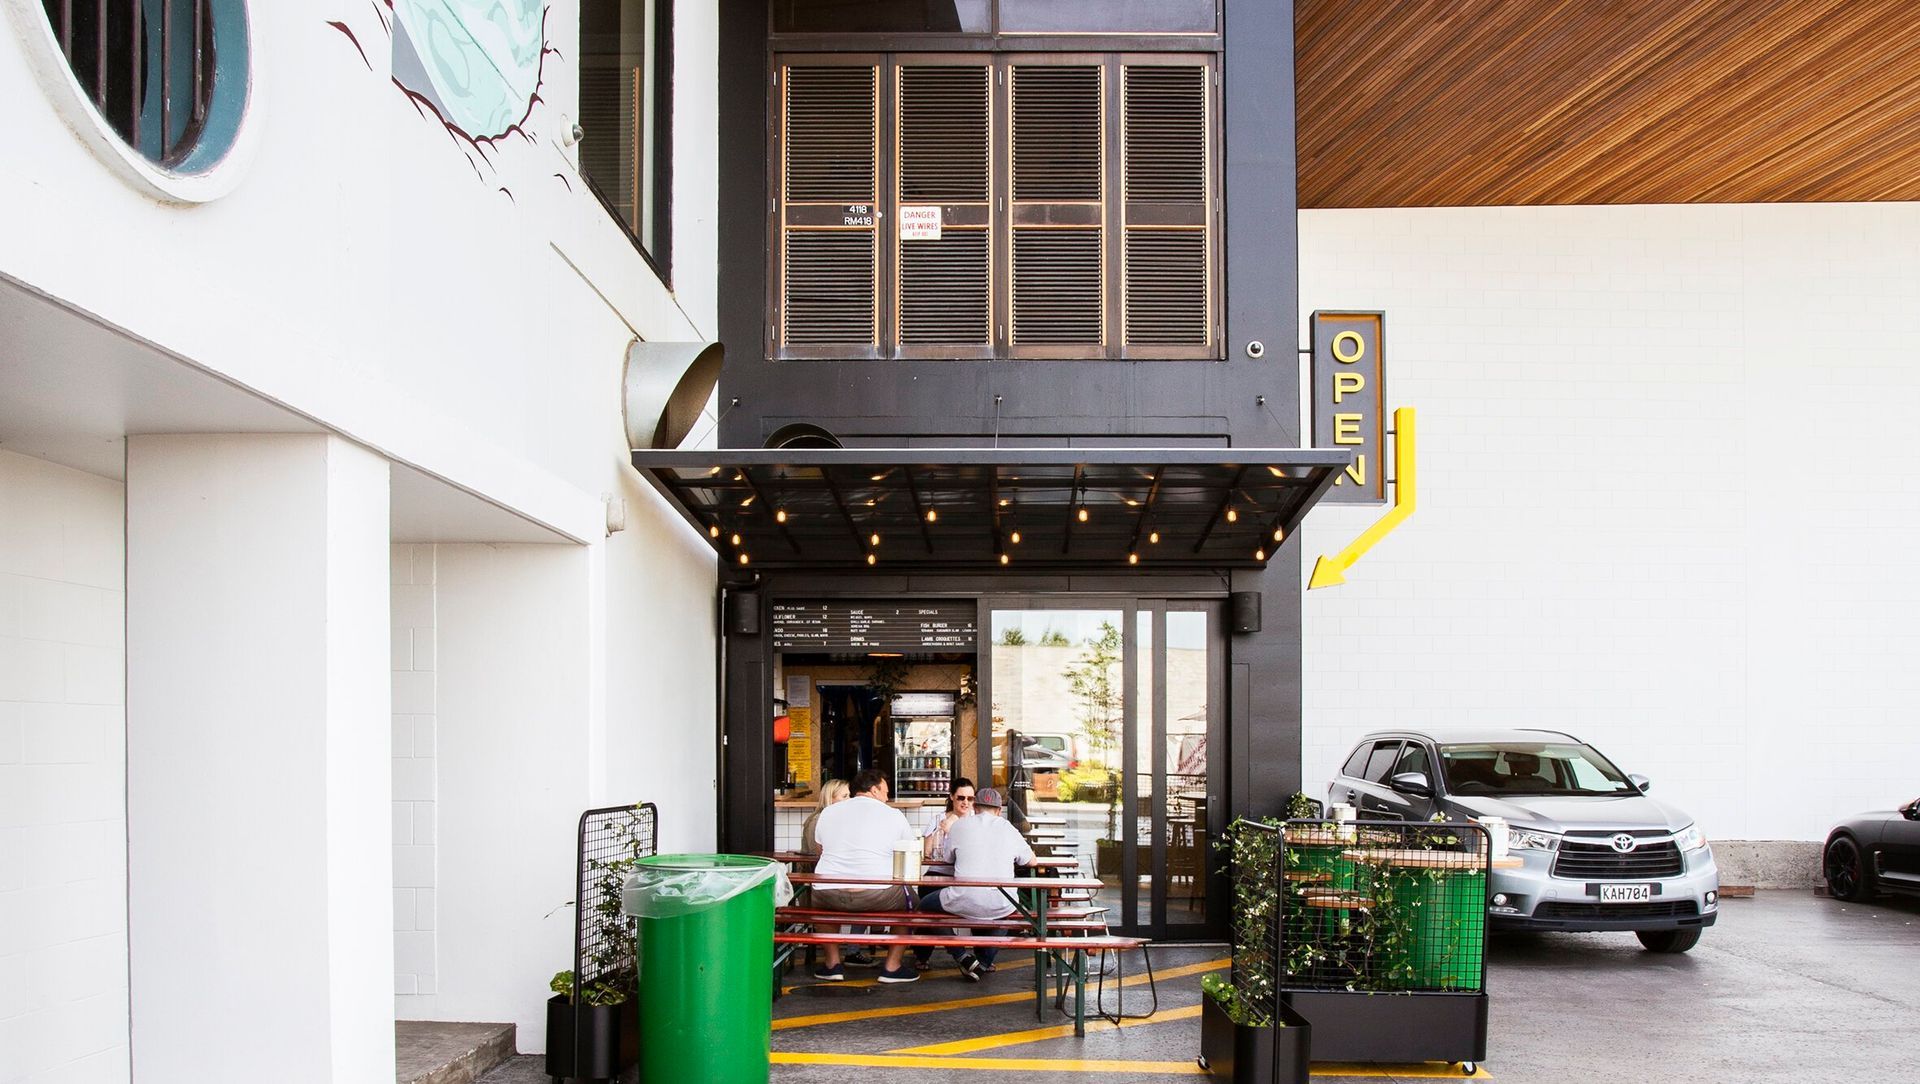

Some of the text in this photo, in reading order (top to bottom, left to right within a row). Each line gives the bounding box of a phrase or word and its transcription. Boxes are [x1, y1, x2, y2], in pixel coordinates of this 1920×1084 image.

[849, 205, 867, 214] 4118
[904, 211, 936, 219] DANGER
[844, 216, 872, 225] RM418
[1332, 330, 1366, 486] OPEN
[1603, 888, 1648, 900] KAH704
